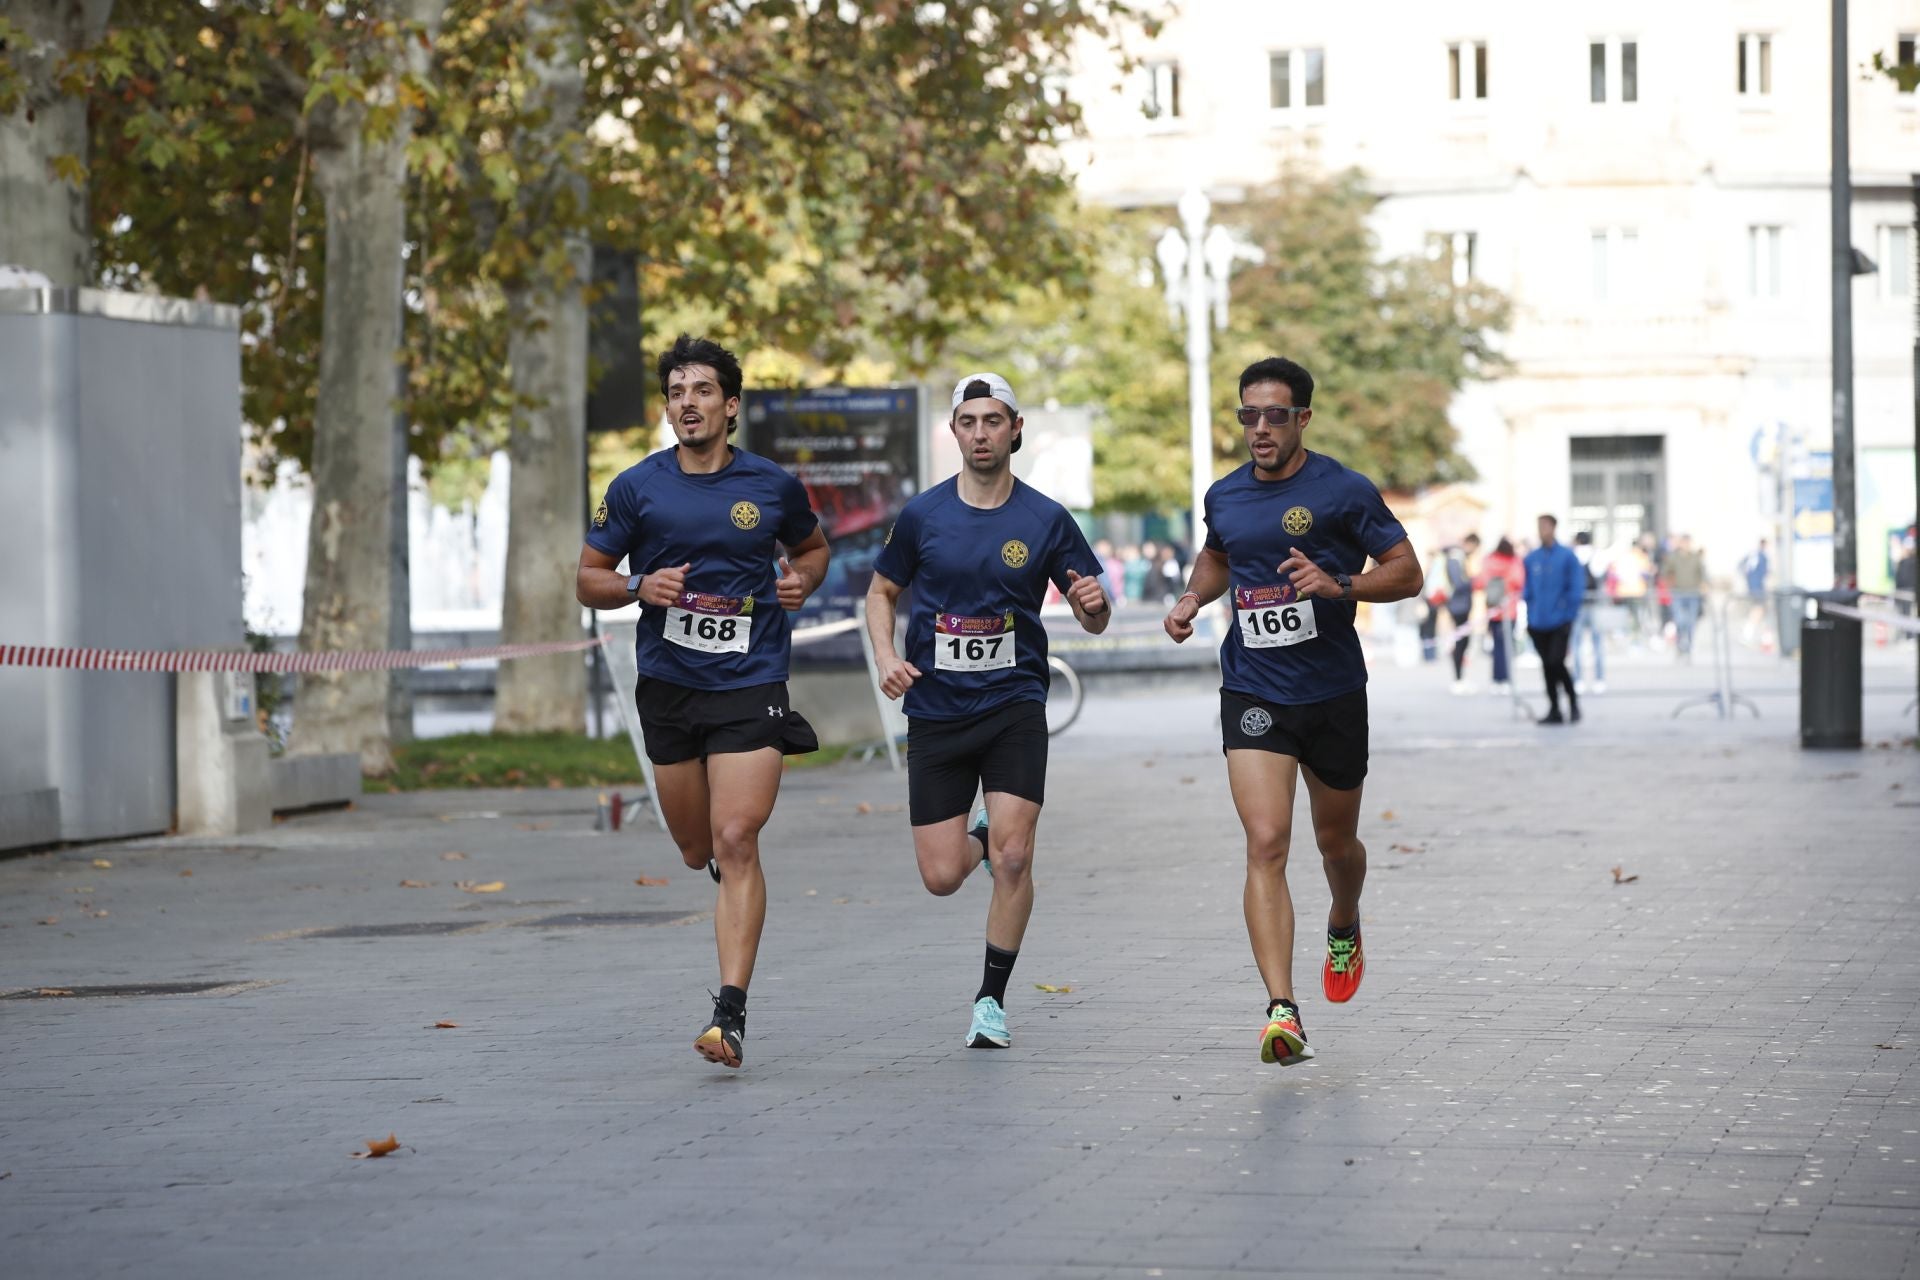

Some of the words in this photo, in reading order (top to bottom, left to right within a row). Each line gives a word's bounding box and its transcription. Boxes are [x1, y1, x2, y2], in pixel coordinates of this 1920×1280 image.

[1253, 591, 1282, 602] EMPRESAS
[679, 613, 737, 641] 168
[1248, 607, 1301, 636] 166
[947, 637, 1004, 661] 167
